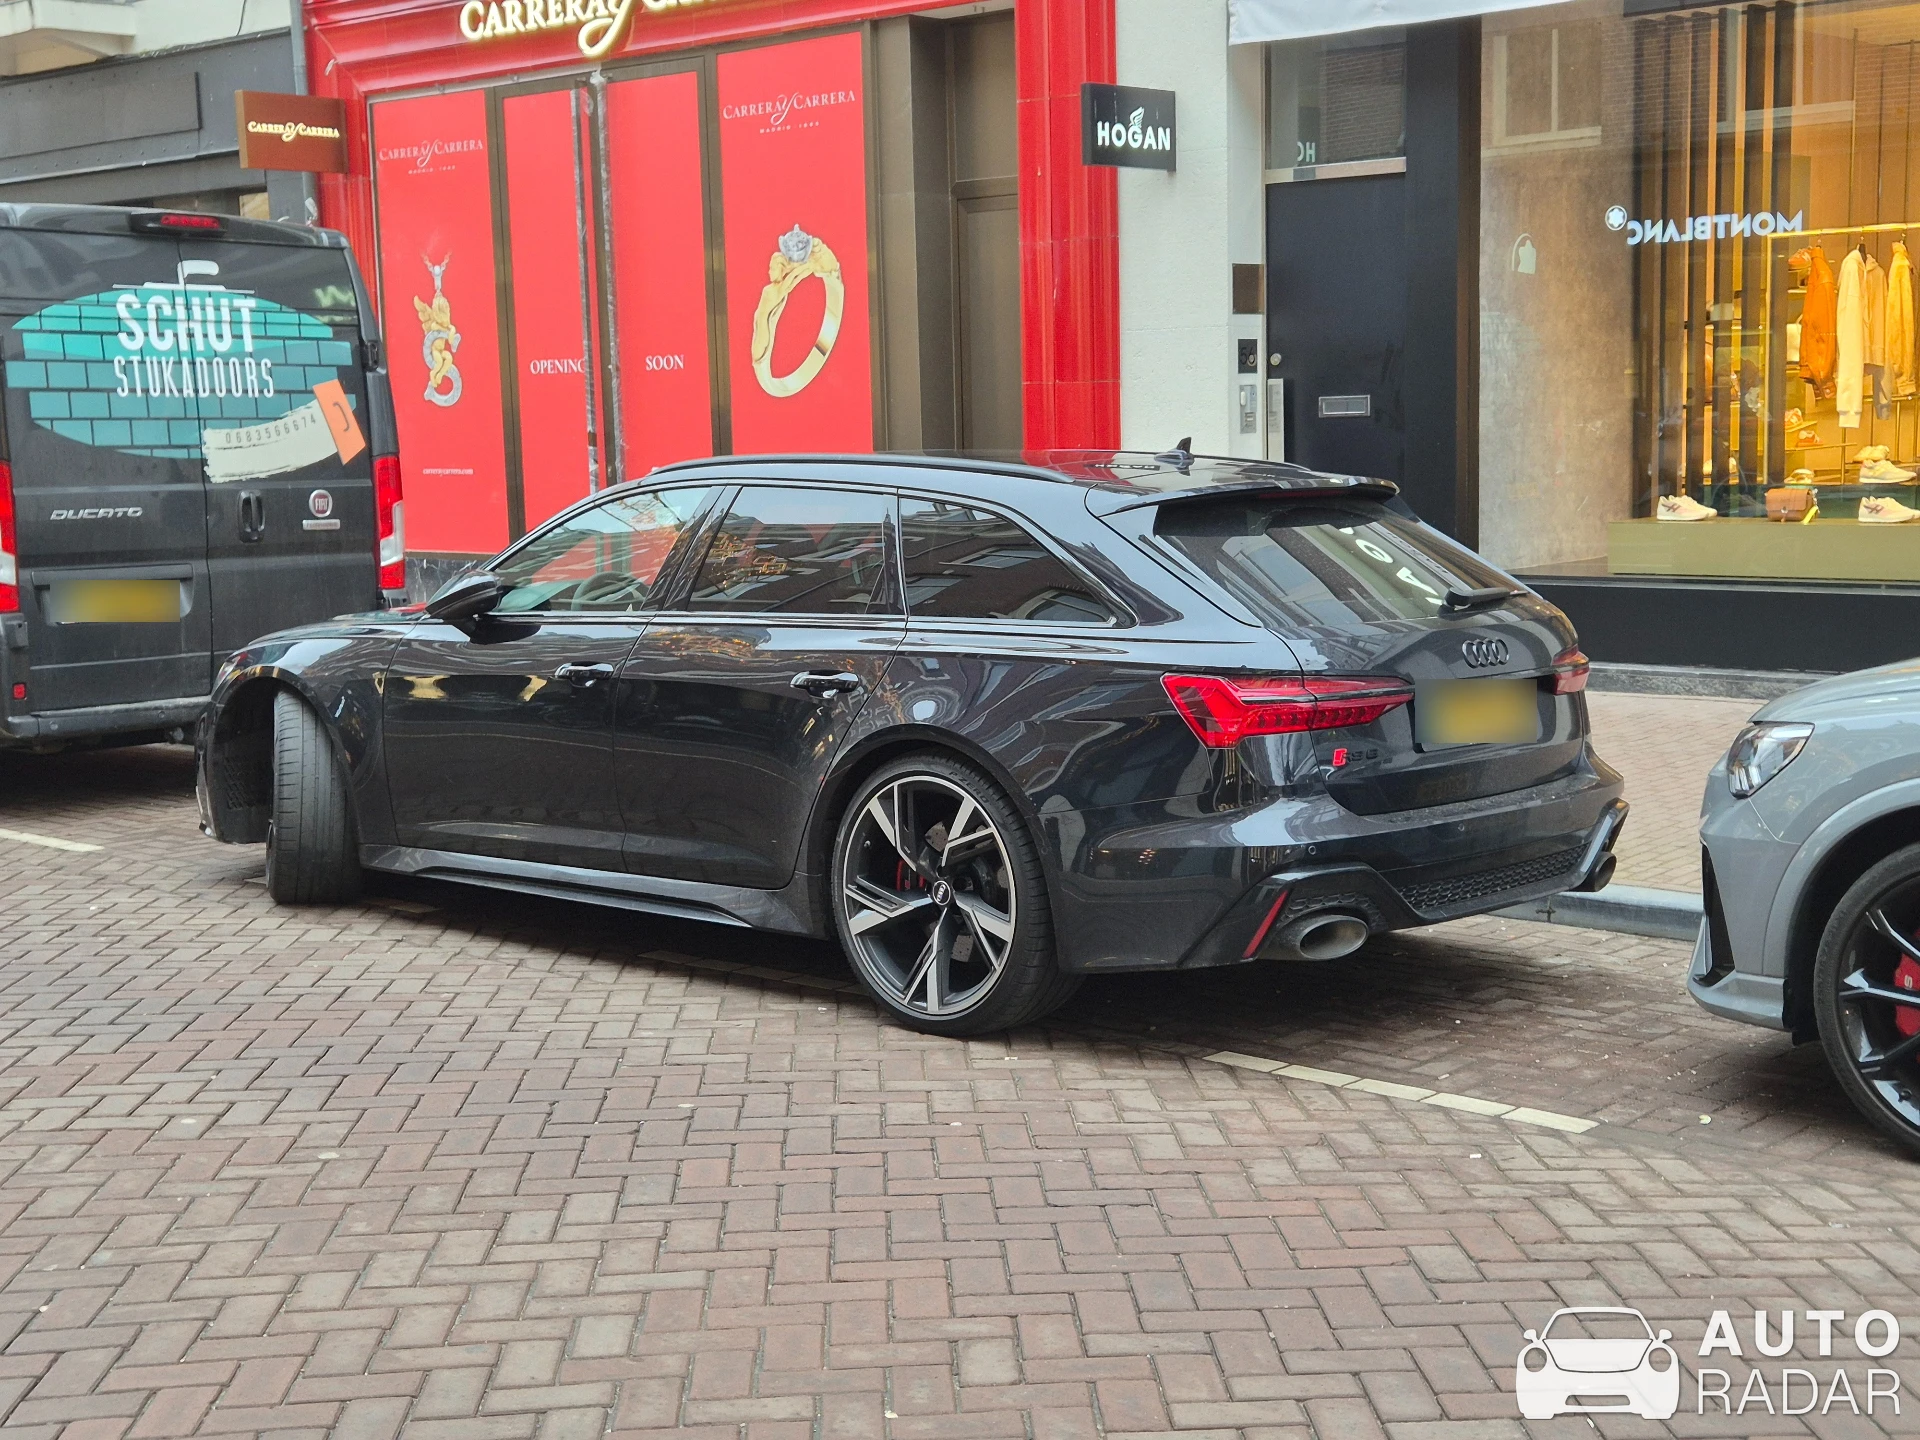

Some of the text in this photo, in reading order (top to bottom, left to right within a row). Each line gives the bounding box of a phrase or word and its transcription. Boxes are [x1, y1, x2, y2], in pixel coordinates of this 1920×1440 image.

[723, 101, 783, 119] CARRERA
[793, 90, 856, 110] CARRERA
[247, 121, 291, 134] CARRERA
[298, 123, 340, 138] CARRERA
[1097, 121, 1171, 151] HOGAN
[434, 139, 483, 155] CARRERA
[116, 293, 256, 353] SCHUT
[645, 354, 685, 371] SOON
[113, 355, 274, 398] STUKADOORS
[314, 497, 328, 511] FIAT
[50, 506, 143, 520] DUCATO
